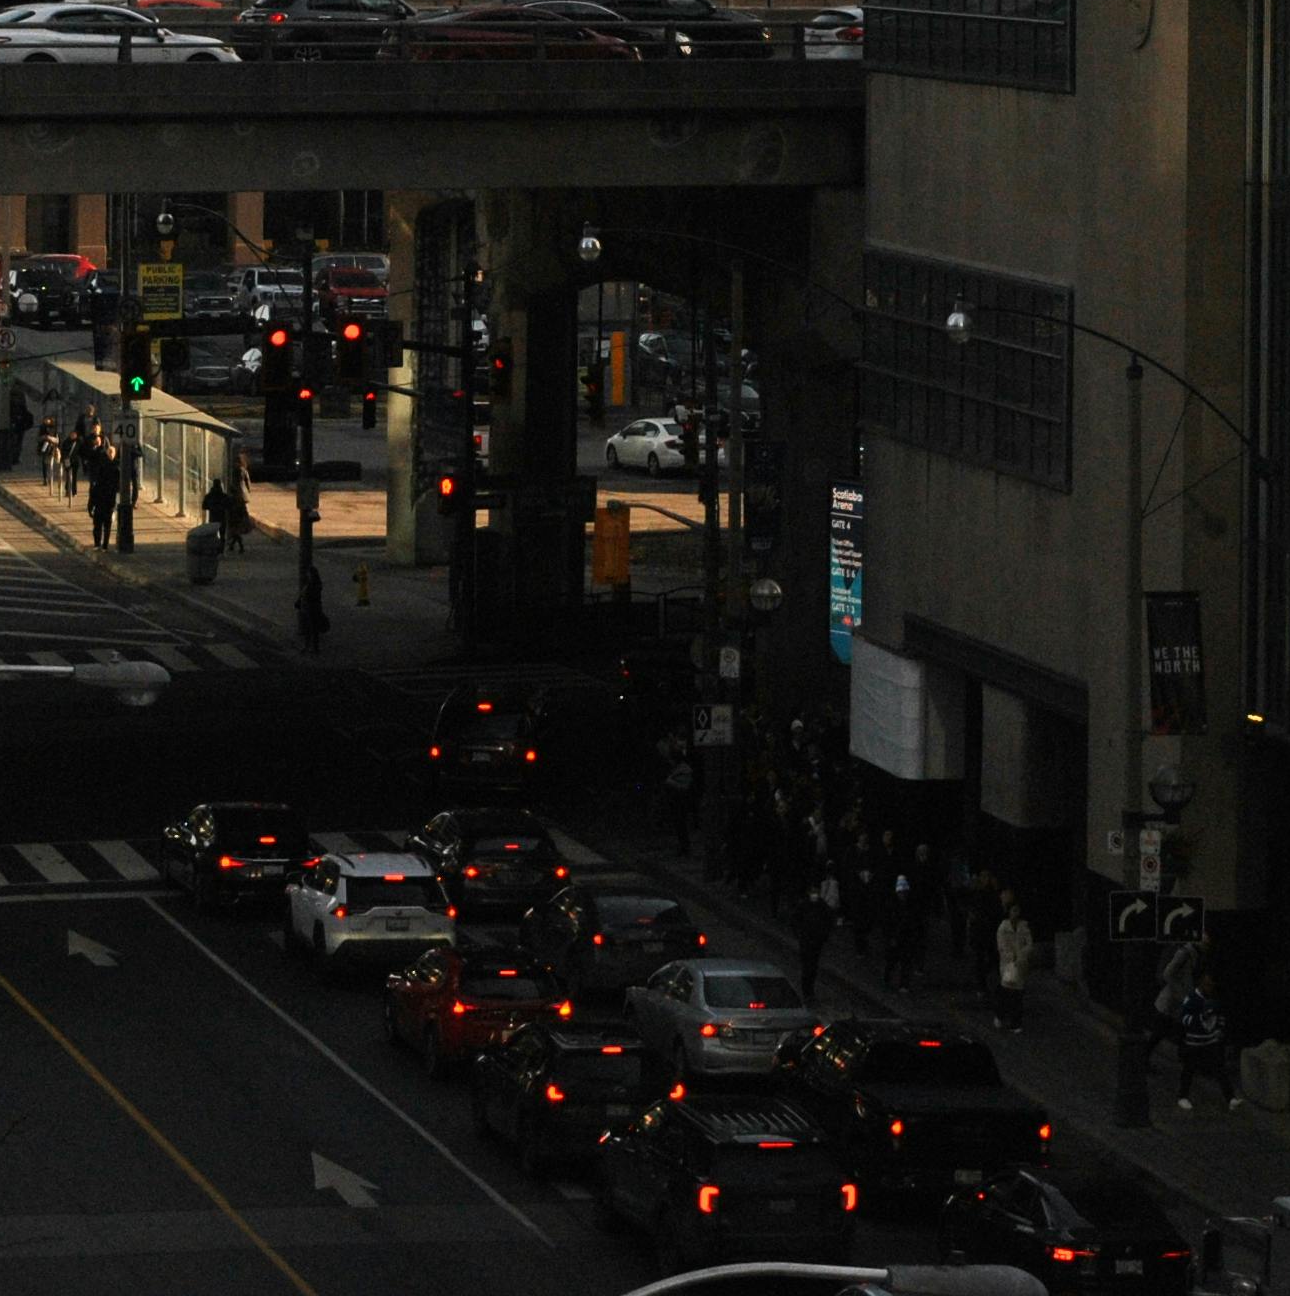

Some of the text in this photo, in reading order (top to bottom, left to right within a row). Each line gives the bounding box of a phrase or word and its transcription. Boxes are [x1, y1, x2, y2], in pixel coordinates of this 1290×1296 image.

[114, 423, 136, 439] 40
[1153, 646, 1200, 659] WE THE
[1154, 659, 1201, 673] NORTH
